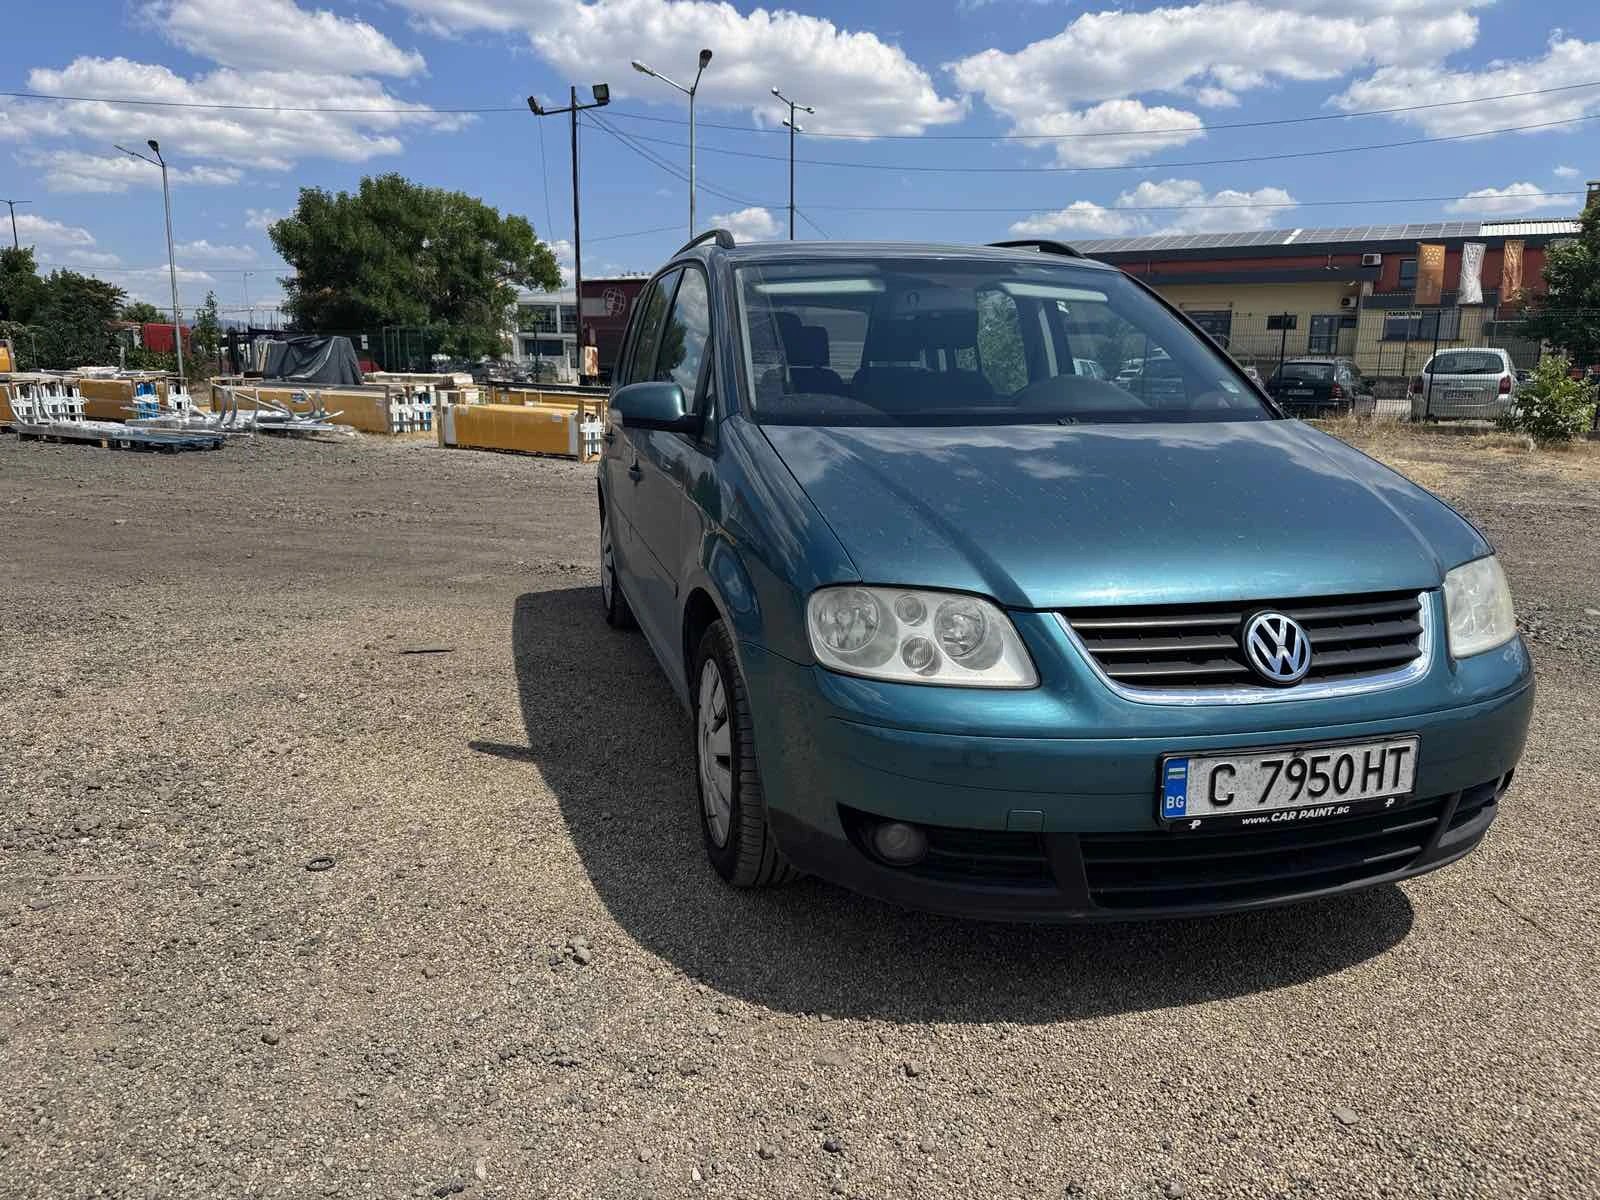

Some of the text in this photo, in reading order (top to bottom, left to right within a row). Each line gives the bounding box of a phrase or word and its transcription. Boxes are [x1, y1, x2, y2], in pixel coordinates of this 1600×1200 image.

[1247, 613, 1310, 680] VW
[1166, 796, 1185, 809] BG
[1208, 763, 1236, 807] C
